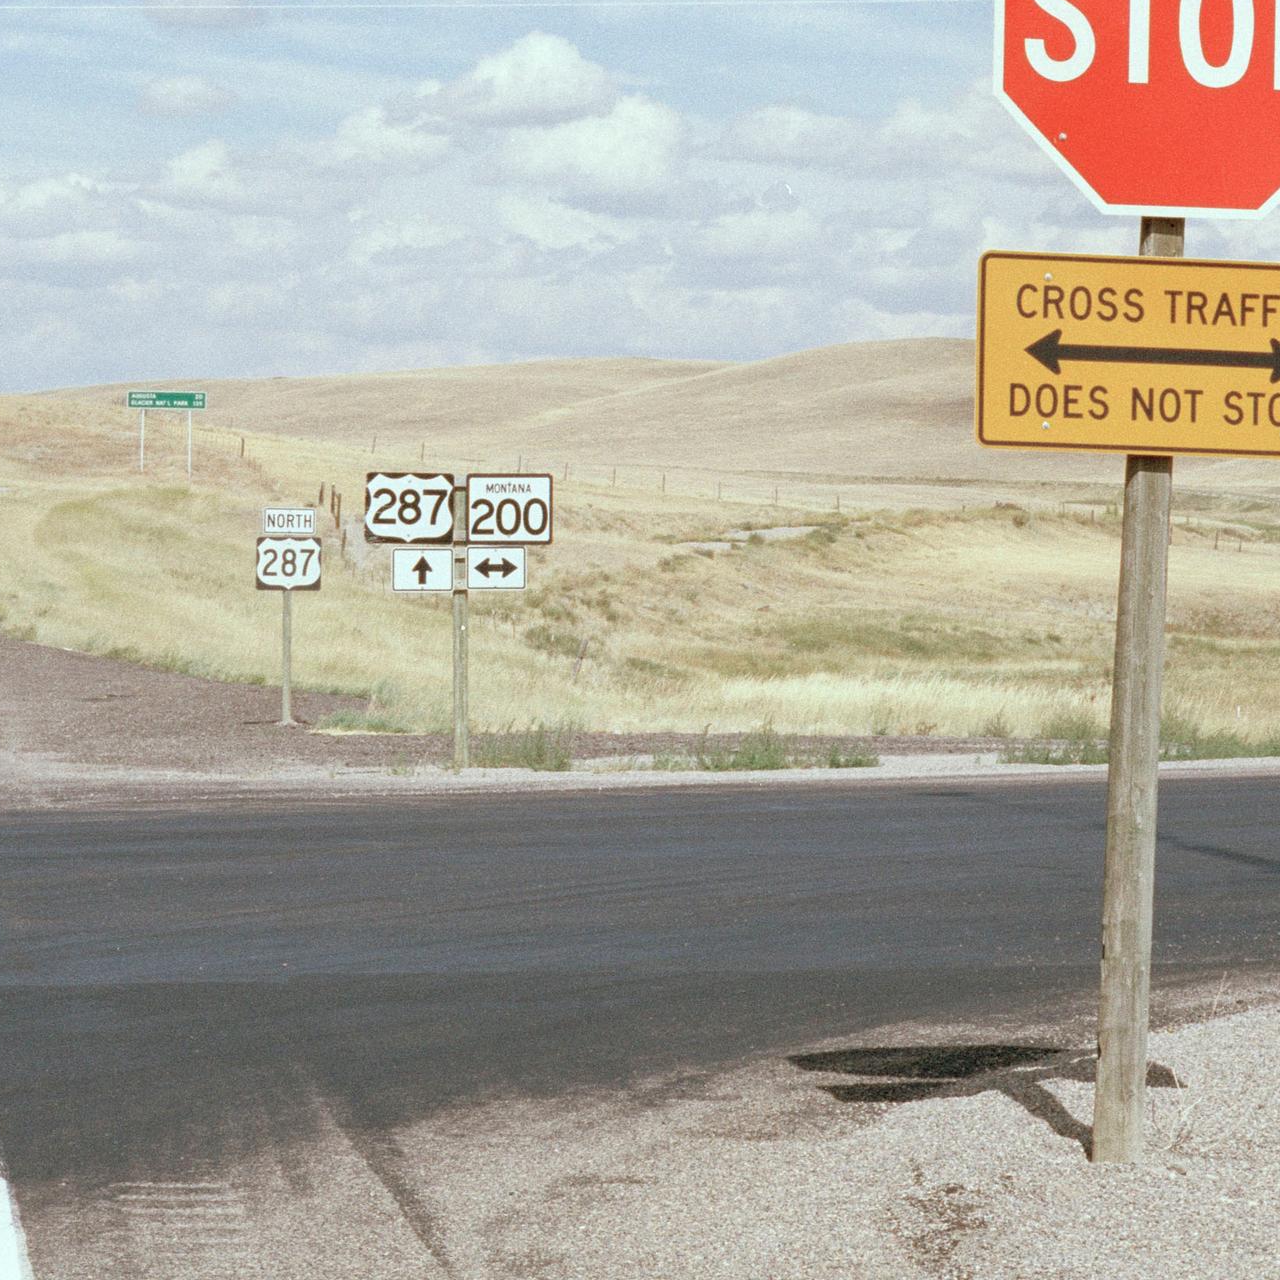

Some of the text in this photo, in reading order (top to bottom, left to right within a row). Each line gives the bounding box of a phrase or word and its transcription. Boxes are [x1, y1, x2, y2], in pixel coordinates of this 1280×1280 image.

[1016, 283, 1145, 323] CROSS
[1009, 382, 1110, 420] DOES
[1130, 387, 1204, 423] NOT
[371, 488, 448, 525] 287
[485, 482, 532, 494] MONTANA
[266, 513, 312, 529] NORTH
[470, 498, 549, 535] 200
[262, 548, 315, 577] 287
